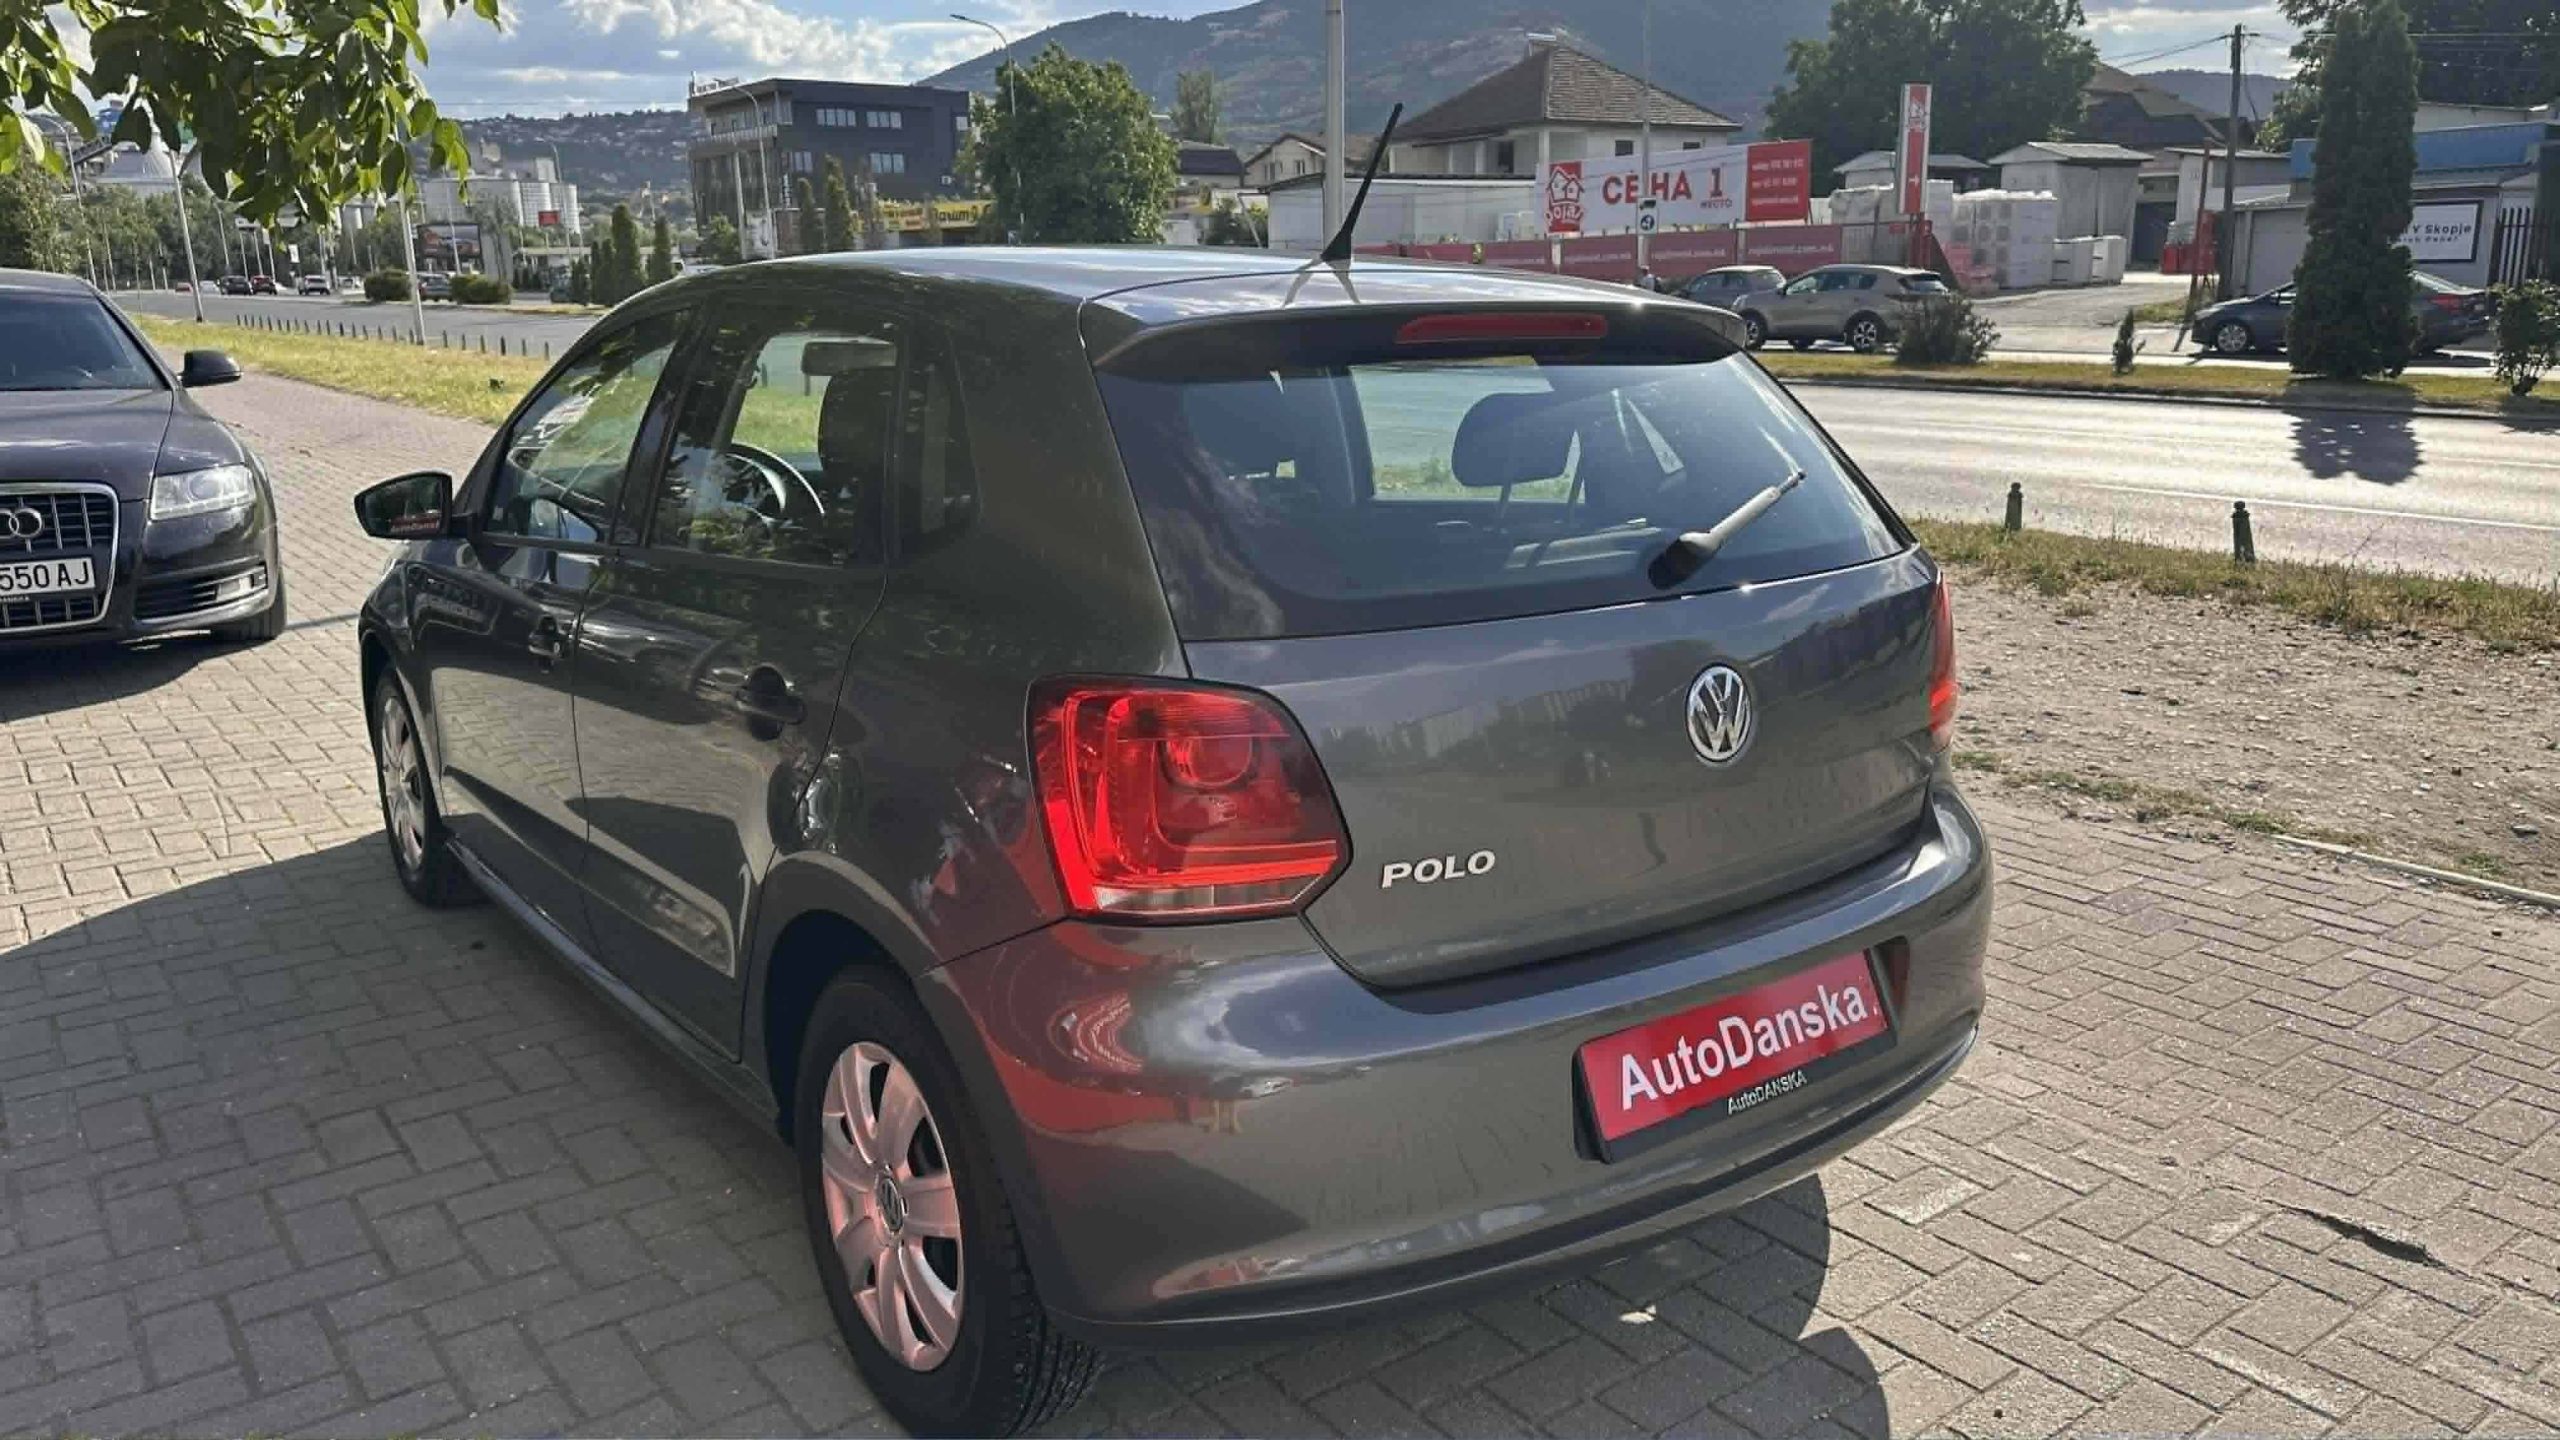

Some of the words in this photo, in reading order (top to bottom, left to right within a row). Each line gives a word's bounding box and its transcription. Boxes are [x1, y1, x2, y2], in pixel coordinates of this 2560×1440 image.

[1709, 167, 1723, 198] 1
[2425, 222, 2472, 235] Skopje
[57, 561, 89, 587] AJ
[1381, 848, 1497, 890] POLO
[1621, 984, 1869, 1112] AutoDanska
[1726, 1069, 1808, 1116] AutoDANSKA
